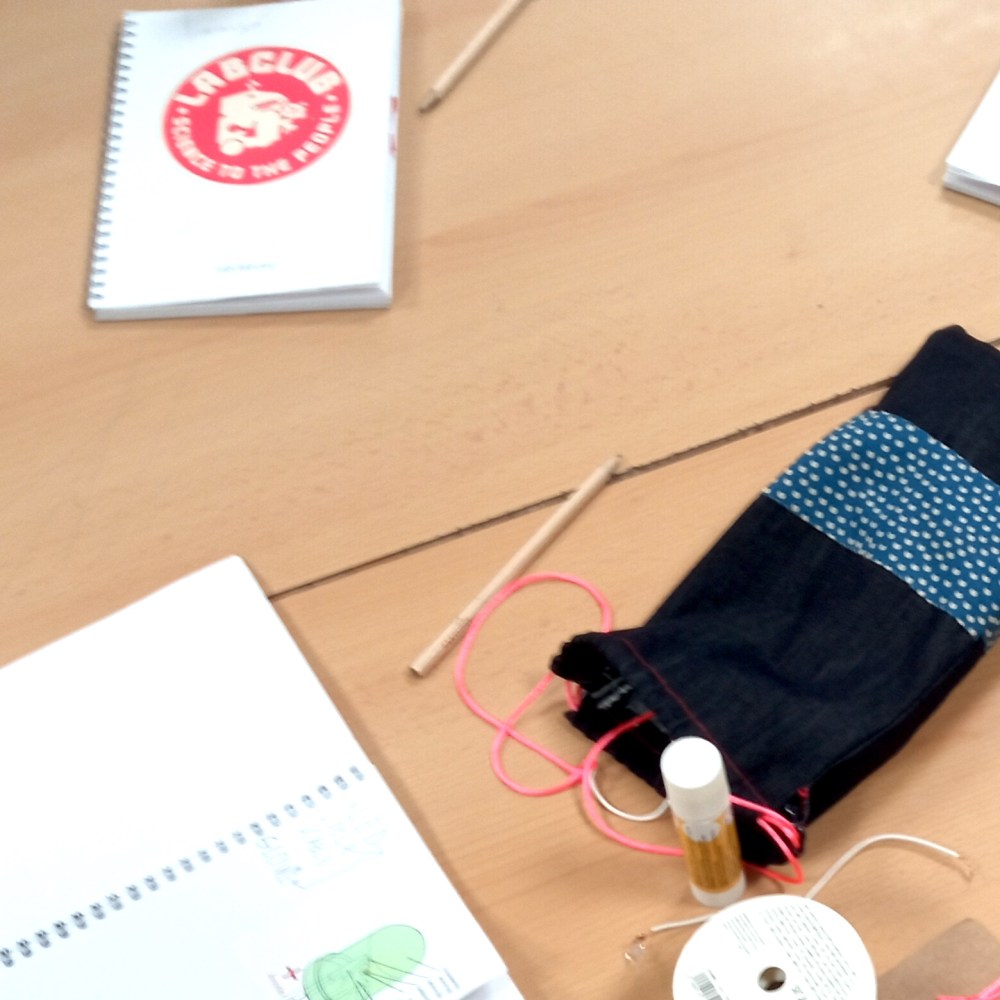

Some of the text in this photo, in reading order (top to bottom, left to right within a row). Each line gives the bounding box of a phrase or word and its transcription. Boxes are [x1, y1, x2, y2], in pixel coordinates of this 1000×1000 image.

[172, 51, 342, 107] LABCLUB
[171, 104, 342, 180] SCIENCE TO THE PEOPLE
